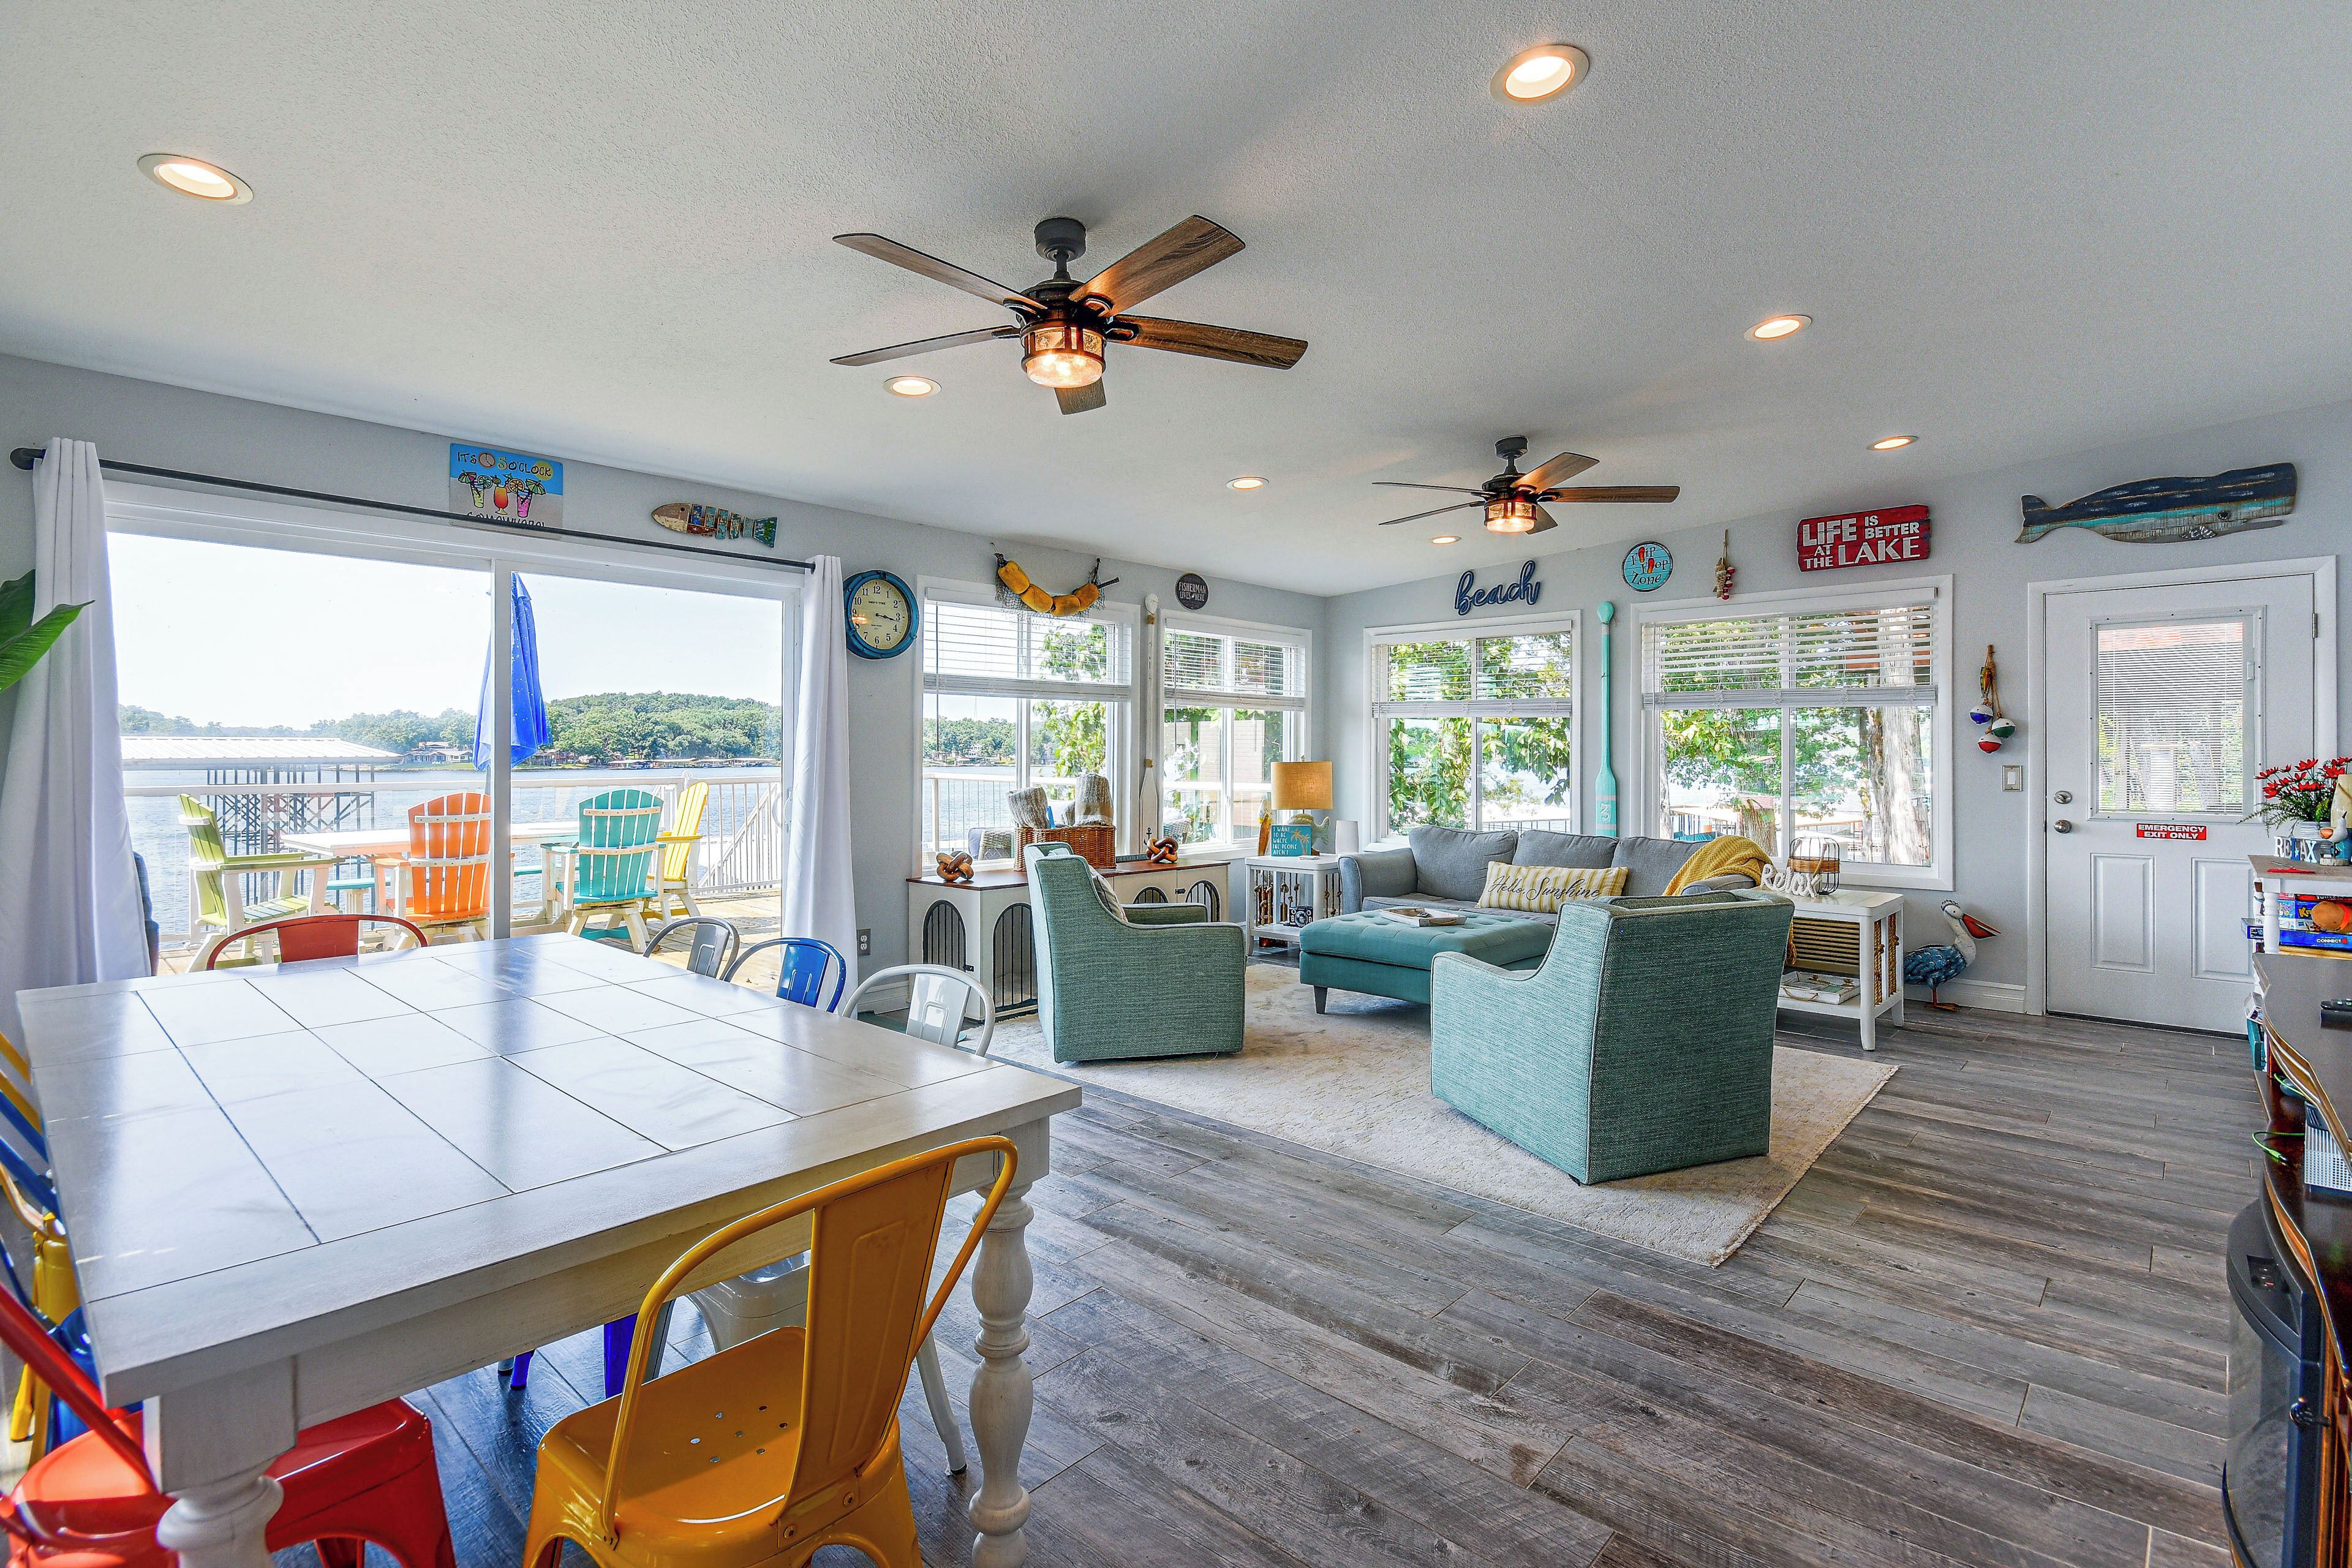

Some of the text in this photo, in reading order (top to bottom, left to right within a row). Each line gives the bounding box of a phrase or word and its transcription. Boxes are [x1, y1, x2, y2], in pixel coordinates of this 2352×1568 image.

[497, 456, 508, 470] 5
[1864, 515, 1879, 527] IS
[1803, 518, 1857, 546] LIFE
[1864, 522, 1920, 540] BETTER
[1814, 544, 1833, 557] AT
[1838, 536, 1920, 565] LAKE
[1803, 556, 1834, 569] THE
[1631, 571, 1662, 585] Zone
[862, 587, 869, 596] 11
[873, 586, 881, 594] 12
[1178, 582, 1206, 594] FISHERMAN
[1454, 560, 1540, 616] beach
[886, 590, 889, 598] 1
[1180, 591, 1191, 600] LIVES
[853, 597, 862, 605] 10
[893, 600, 898, 608] 2
[852, 608, 857, 617] 9
[895, 612, 900, 621] 3
[892, 624, 898, 633] 4
[864, 631, 869, 640] 7
[875, 636, 879, 644] 6
[886, 633, 891, 641] 5
[2138, 824, 2205, 832] EMERGENCY
[2274, 836, 2318, 864] RELAX
[1760, 863, 1822, 898] Relax
[1487, 875, 1602, 900] Hello, Sunshine
